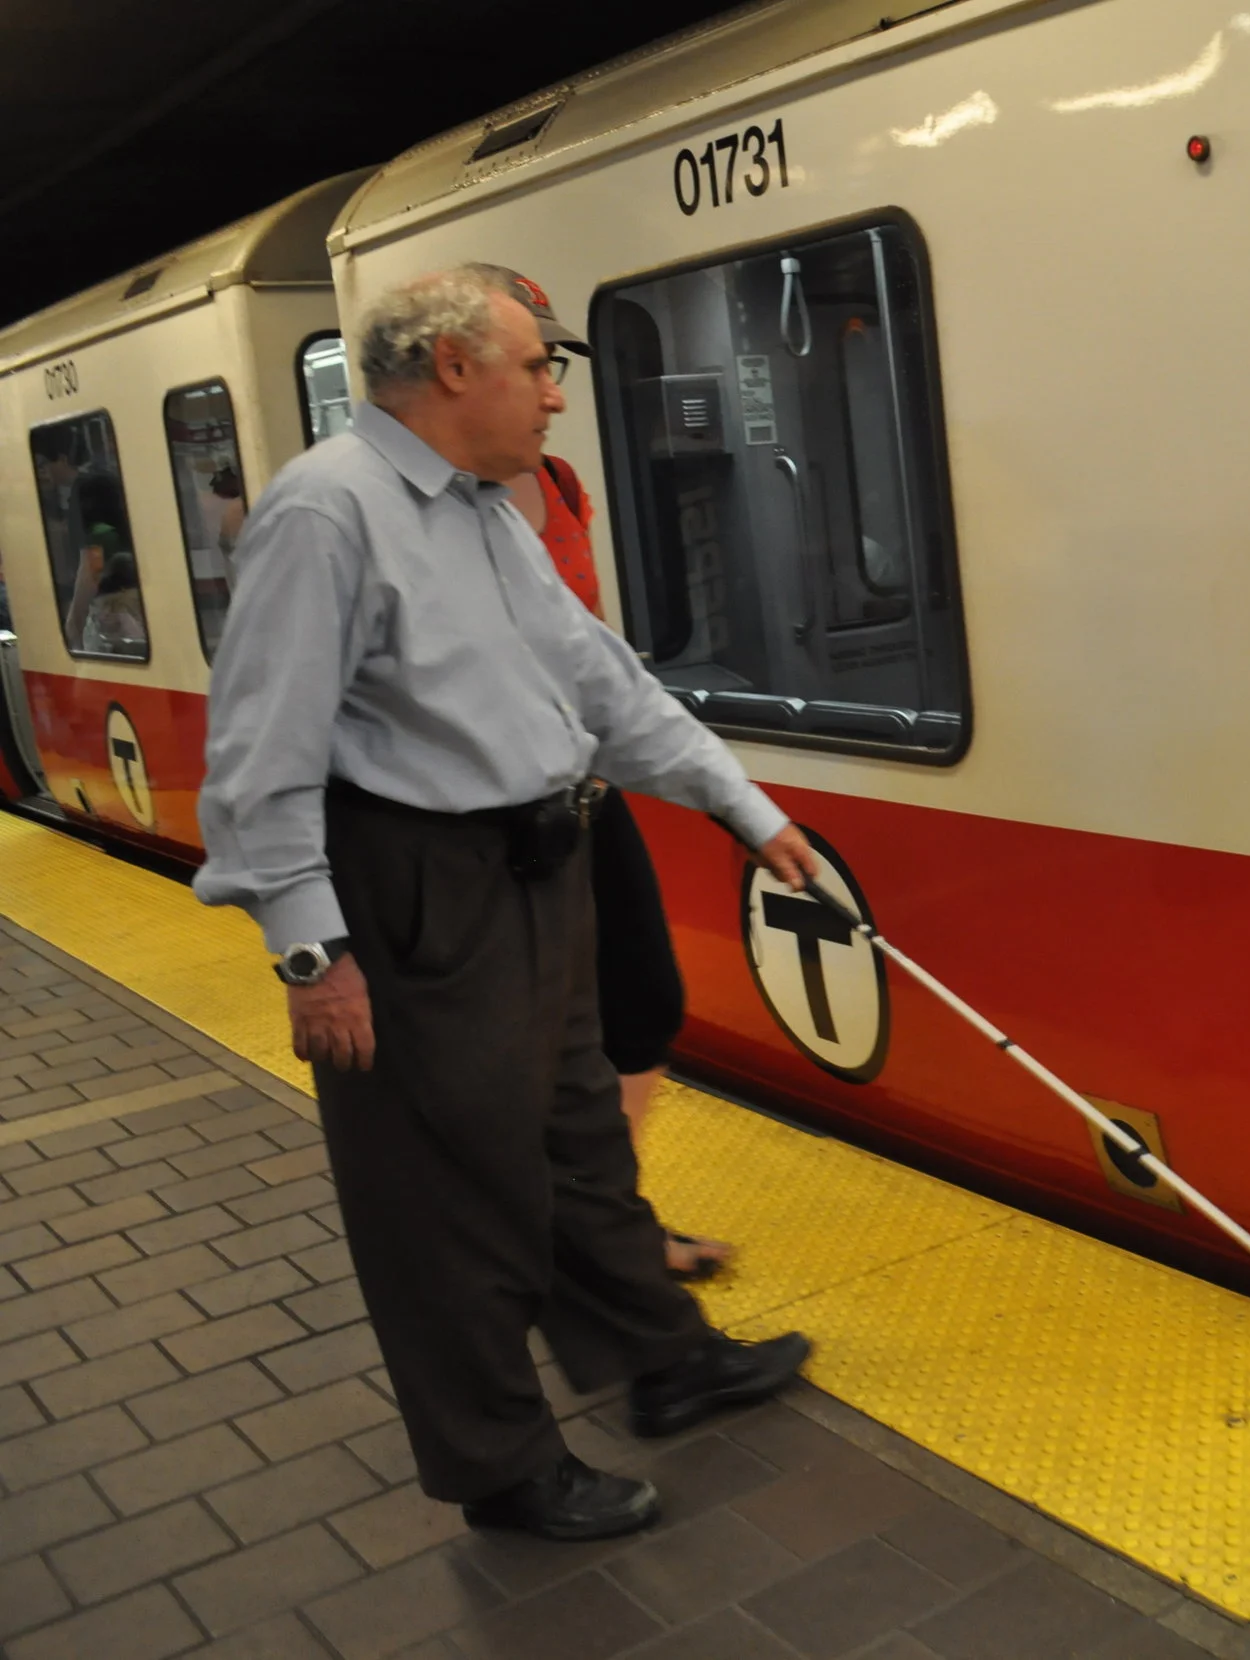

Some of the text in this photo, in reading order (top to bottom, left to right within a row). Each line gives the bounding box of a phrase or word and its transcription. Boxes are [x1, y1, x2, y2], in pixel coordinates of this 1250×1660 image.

[674, 118, 789, 216] 01731
[112, 738, 137, 814] T
[761, 890, 853, 1045] T
